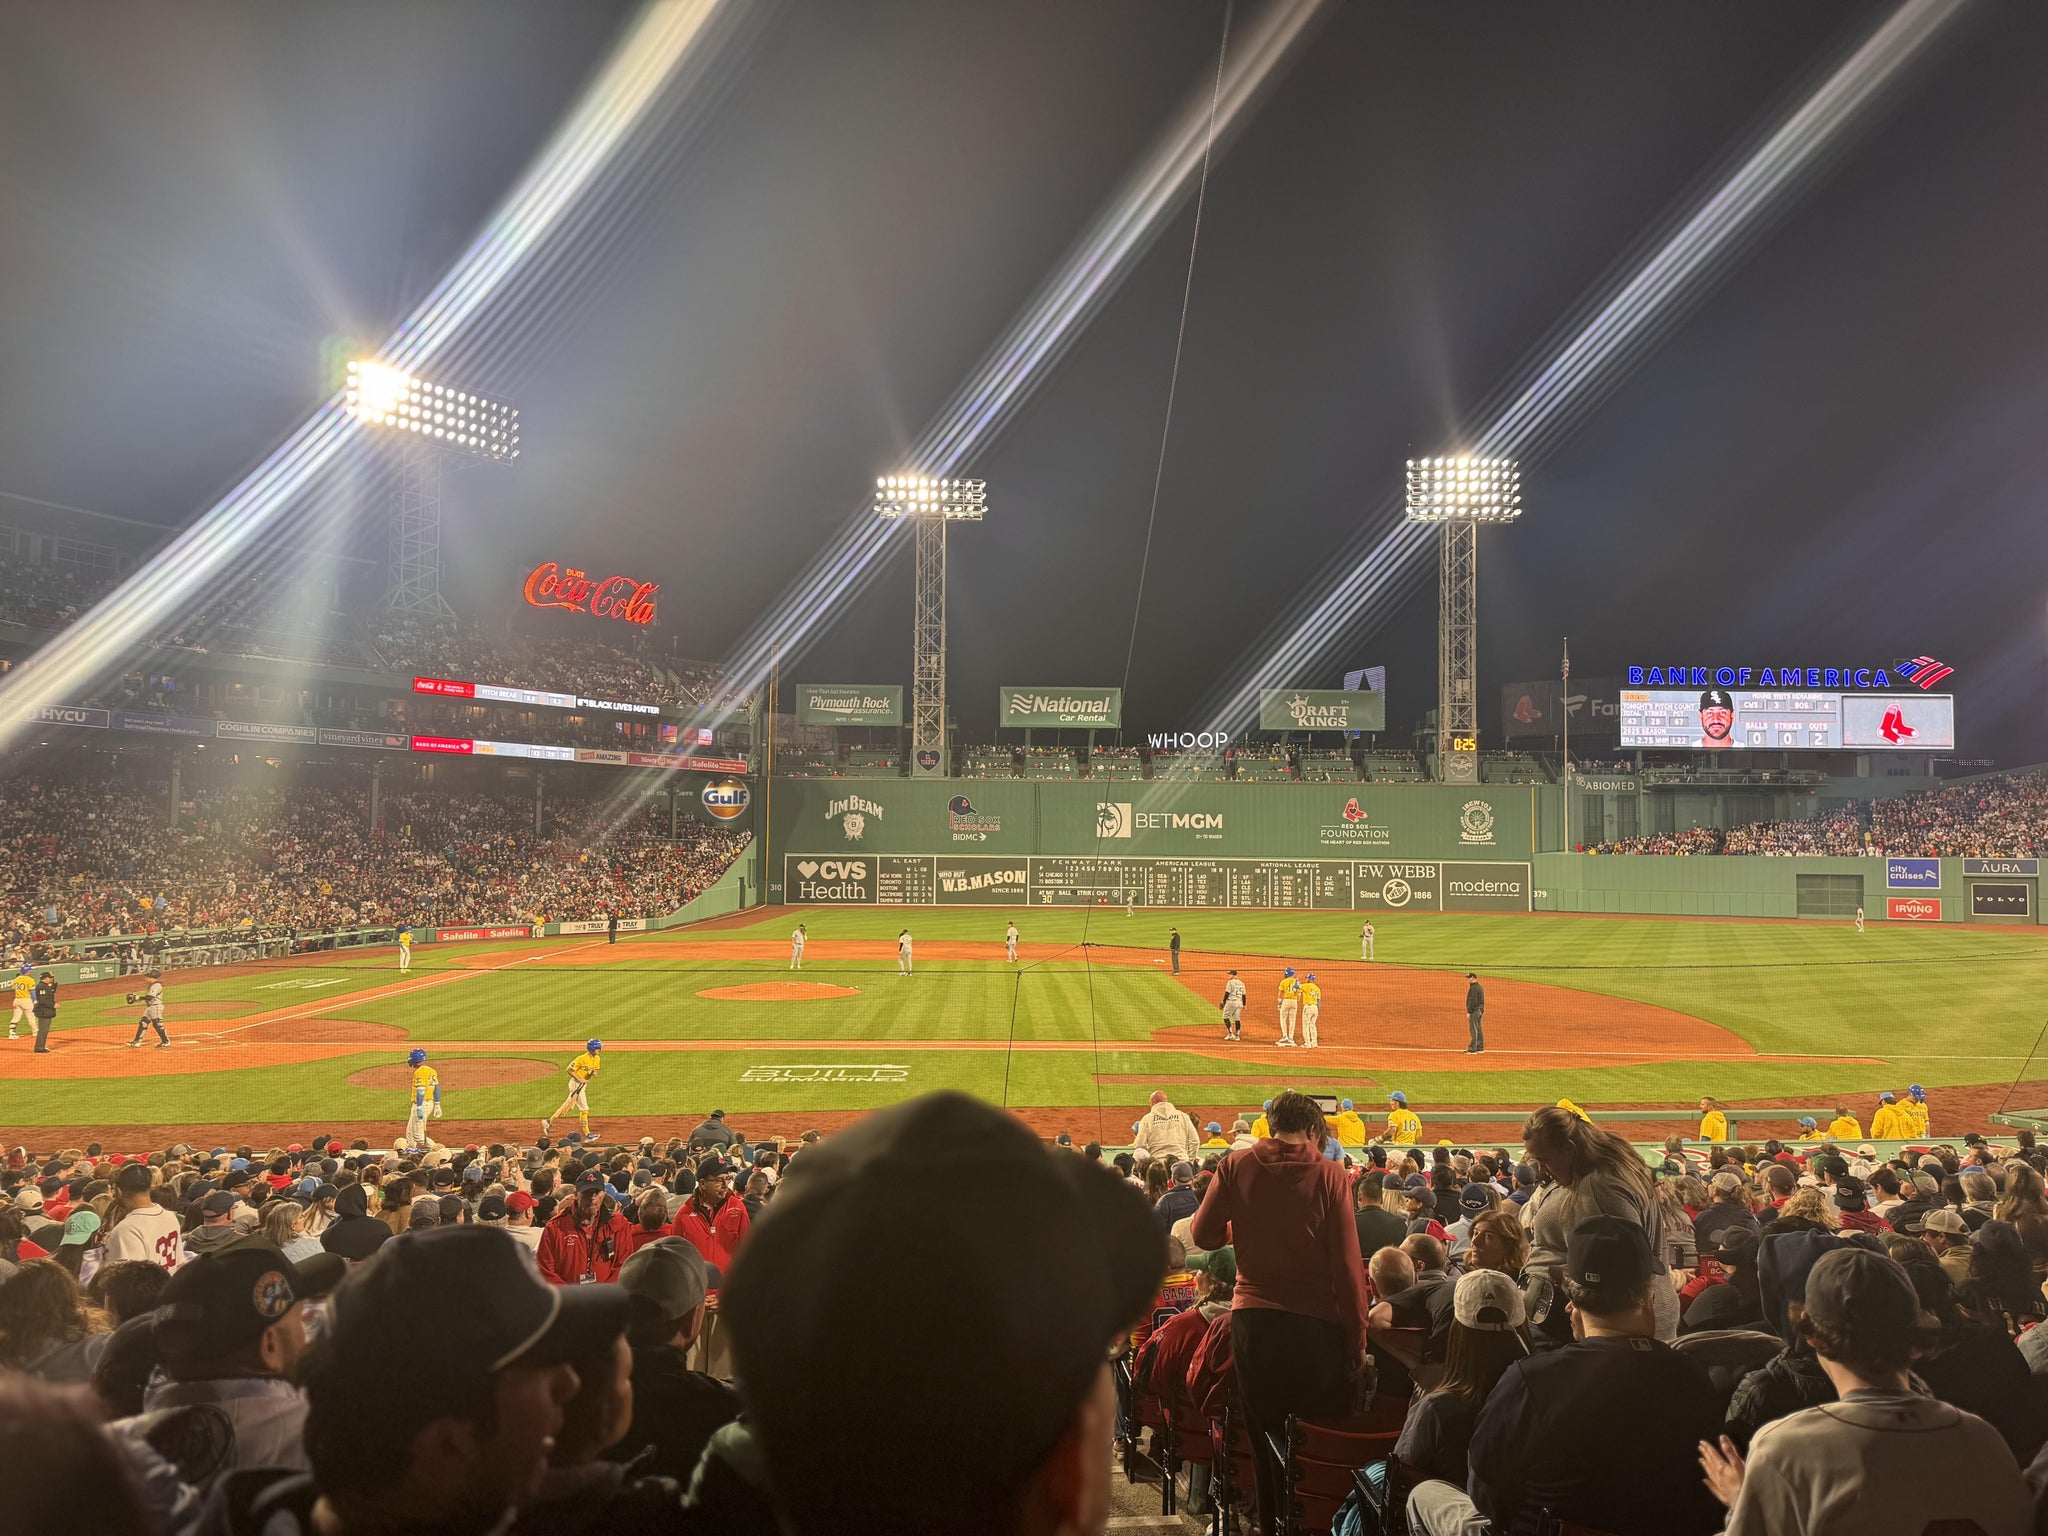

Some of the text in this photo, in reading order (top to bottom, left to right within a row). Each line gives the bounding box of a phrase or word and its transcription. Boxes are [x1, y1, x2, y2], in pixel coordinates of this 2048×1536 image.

[566, 569, 585, 578] ENJOY
[524, 562, 659, 624] Coca-Cola
[1628, 666, 1890, 687] BANK OF AMERICA
[589, 700, 612, 709] BLACK
[613, 702, 633, 711] LIVES
[633, 704, 659, 714] MATTER
[809, 696, 890, 708] Plymouth Rock
[41, 708, 87, 722] HYCU
[1290, 705, 1349, 718] DRAFT
[1060, 714, 1106, 722] Car Rental
[1298, 716, 1348, 727] KINGS
[219, 723, 315, 736] COGHLIN COMPANIES
[1745, 722, 1828, 730] BALLS STRIKES OUTS
[324, 733, 383, 744] vineyard vines
[1147, 732, 1228, 748] WHOOP
[1454, 738, 1476, 750] 0:25
[1672, 737, 1687, 745] 1.22
[1753, 732, 1823, 746] 0 0 2
[596, 753, 621, 761] AMAZING
[1585, 781, 1635, 791] ABIOMED
[704, 790, 747, 805] Gulf
[825, 795, 884, 821] JIM BEAM
[1462, 800, 1492, 811] IBEW 103
[954, 816, 1000, 824] RED SOX
[1135, 813, 1223, 829] BETMGM
[1321, 830, 1389, 838] FOUNDATION
[820, 861, 866, 879] CVS
[1358, 865, 1435, 879] F.W. WEBB
[1890, 865, 1907, 873] city
[800, 882, 866, 900] Health
[1450, 879, 1519, 893] moderna
[1041, 895, 1052, 904] 30
[1360, 890, 1431, 899] Since 1866
[1533, 890, 1547, 898] 379
[1895, 904, 1933, 913] IRVING
[442, 929, 524, 941] Safelite Safelite
[741, 1069, 909, 1078] BUILD
[1402, 1120, 1417, 1132] 16
[155, 1231, 178, 1271] 33
